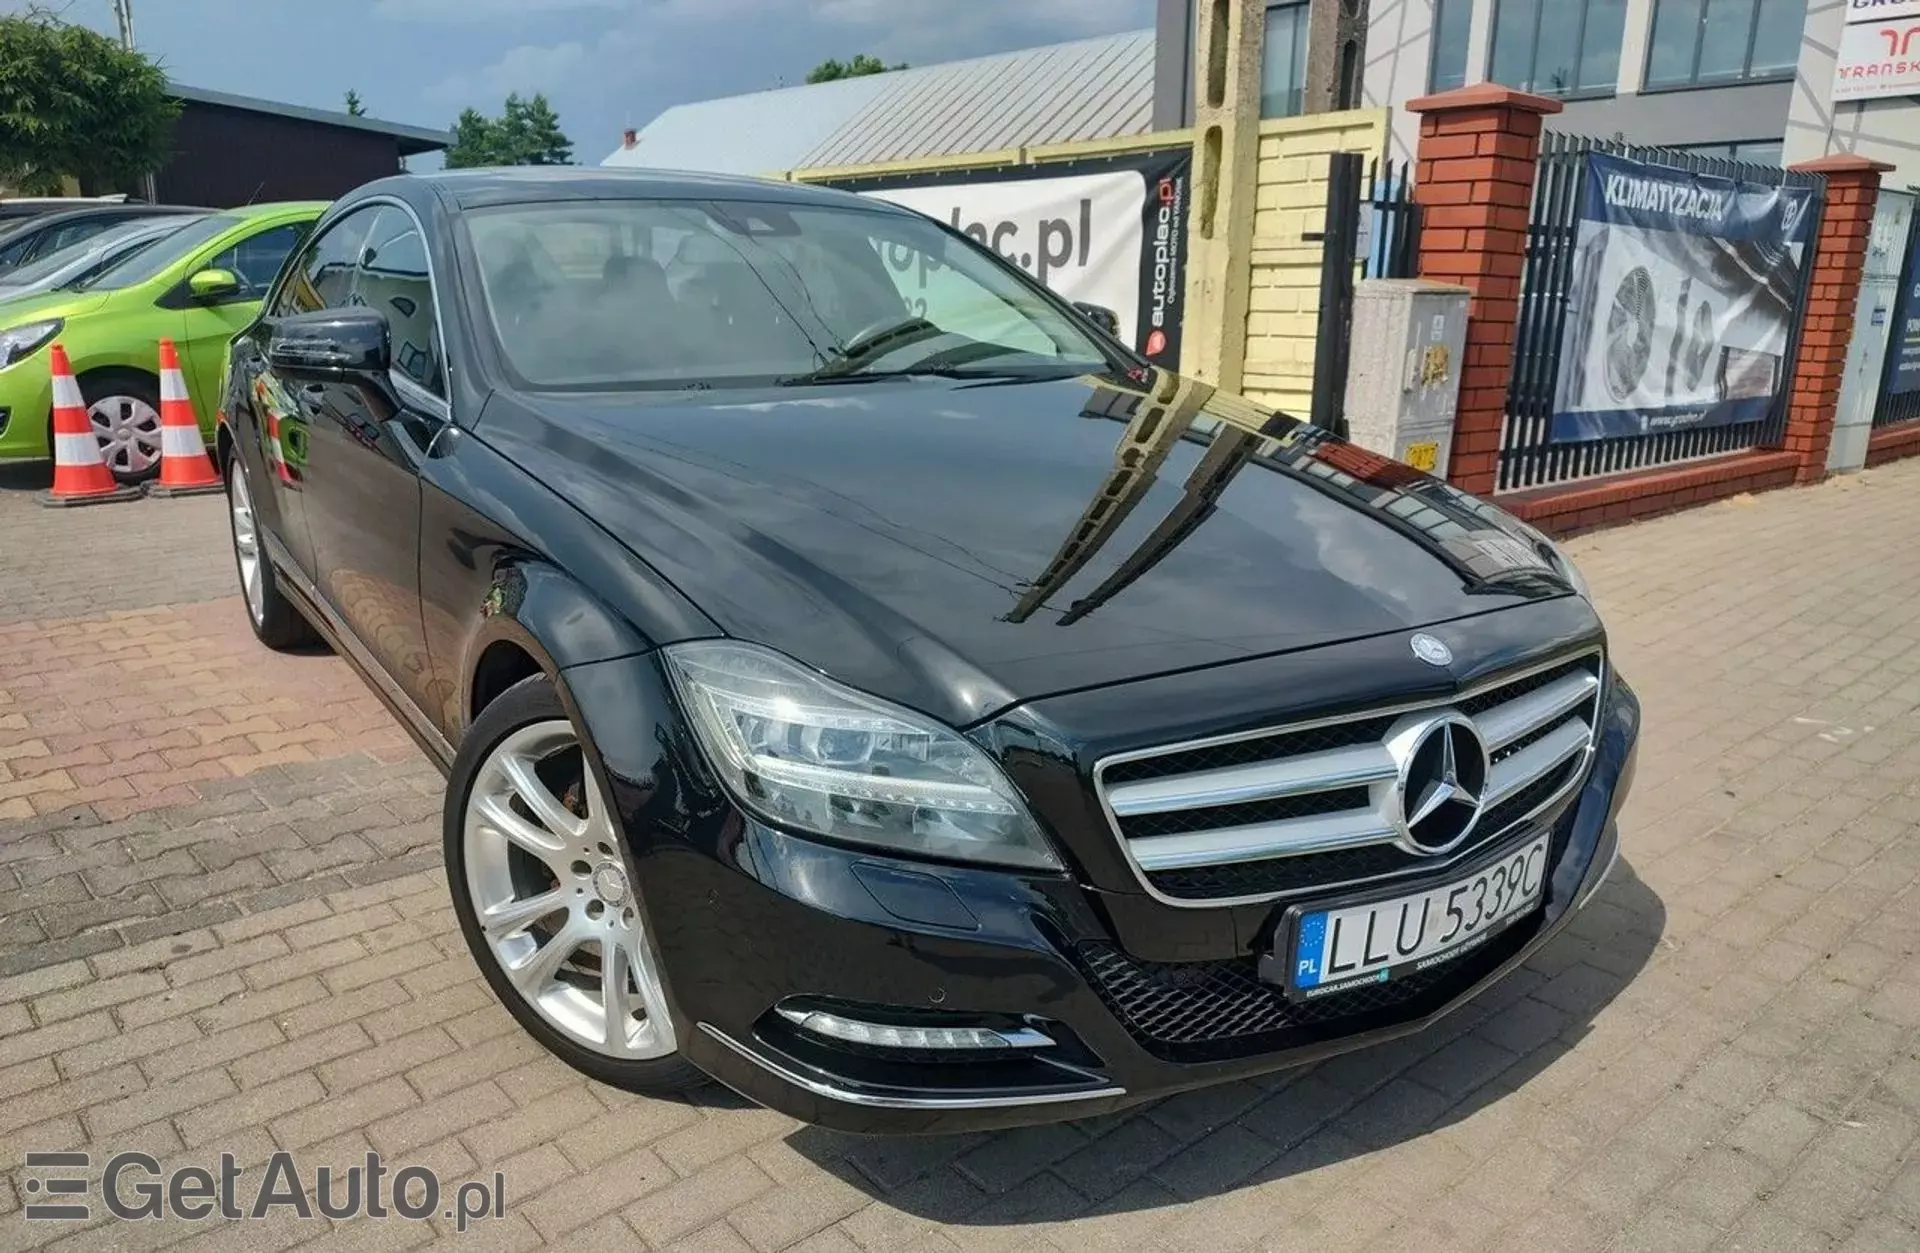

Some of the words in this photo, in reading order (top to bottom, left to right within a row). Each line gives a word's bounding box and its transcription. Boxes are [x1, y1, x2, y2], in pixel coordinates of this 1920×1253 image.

[1604, 174, 1723, 222] KLIMATYZACJA
[1328, 897, 1430, 975] LLU
[1439, 843, 1543, 943] 5339C
[1297, 959, 1318, 977] PL
